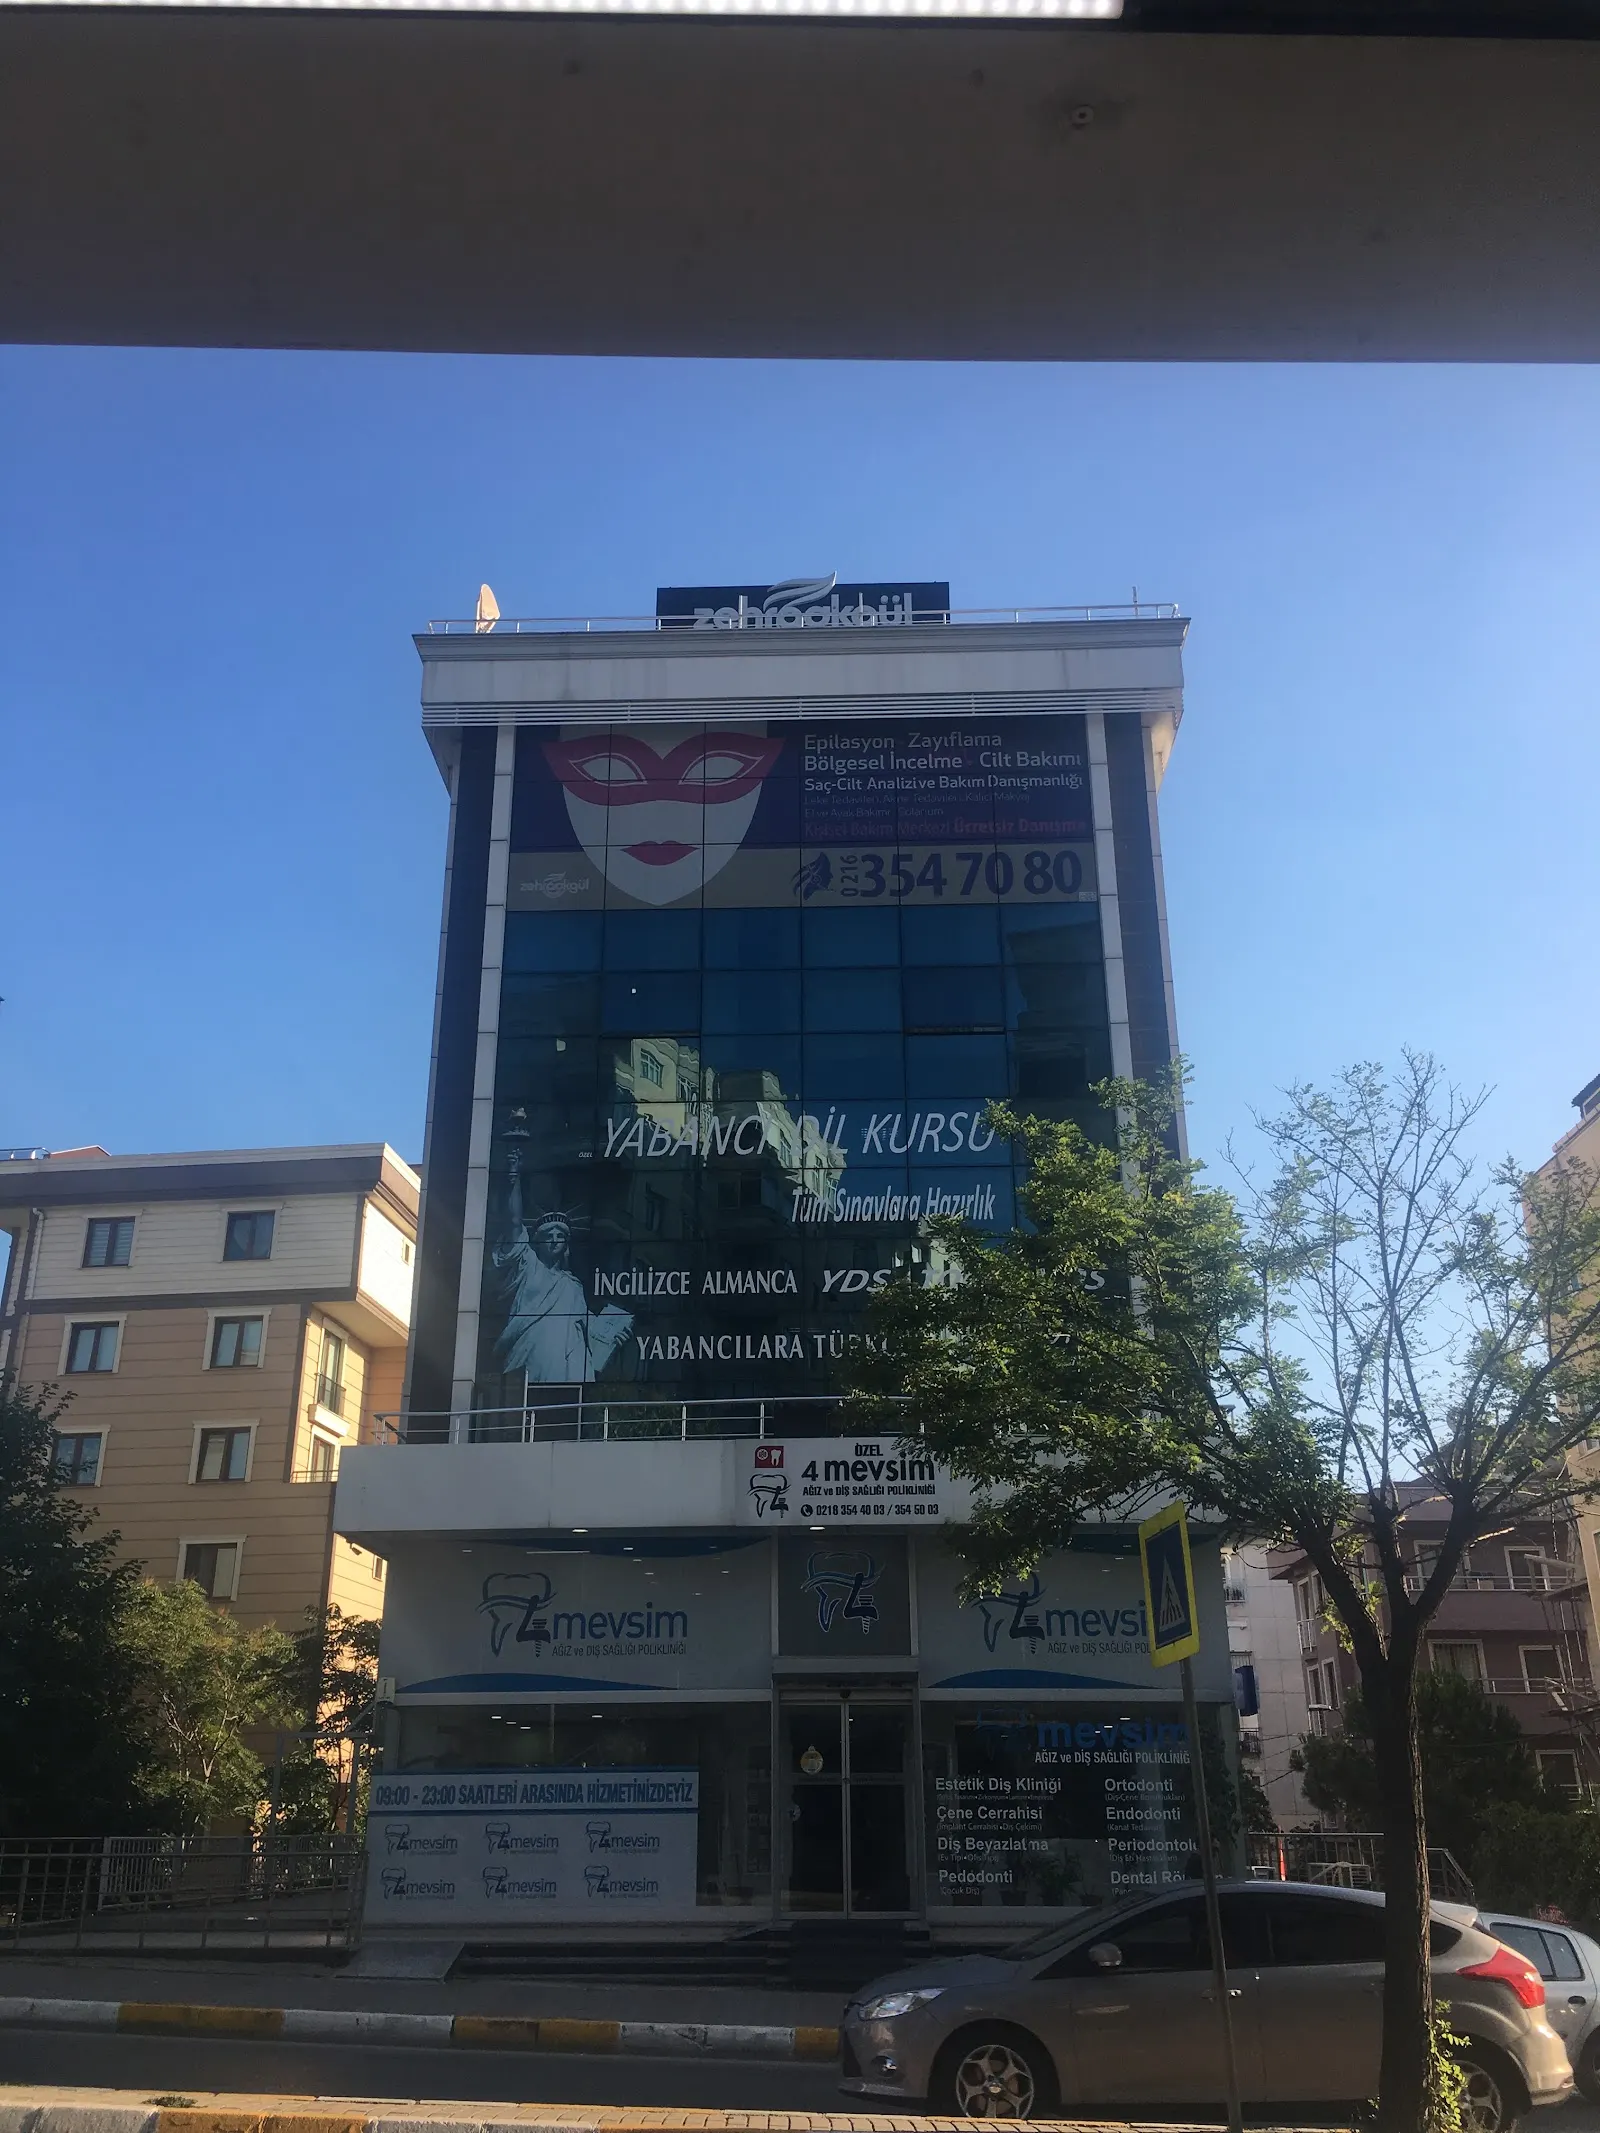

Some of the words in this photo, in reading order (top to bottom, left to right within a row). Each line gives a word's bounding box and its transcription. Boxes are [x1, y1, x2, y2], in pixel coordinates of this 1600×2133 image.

[804, 733, 895, 752] Epilasyon
[907, 732, 1002, 750] Zayıflama
[804, 755, 885, 775] Bölgesel
[890, 753, 963, 769] İncelme
[979, 752, 1012, 767] Cilt
[1016, 751, 1082, 768] Bakımı
[804, 777, 863, 795] Saç-Cilt
[938, 774, 985, 789] Bakım
[987, 774, 1084, 792] Danışmanlığı
[860, 852, 948, 898] 354
[955, 851, 1014, 897] 70
[1023, 850, 1083, 895] 80
[602, 1114, 769, 1158] YABANCI
[862, 1111, 995, 1154] KURSU
[790, 1190, 829, 1223] Tüm
[833, 1189, 921, 1222] Sınavlara
[925, 1184, 997, 1220] Hazırlık
[594, 1267, 690, 1296] İNGİLİZCE
[702, 1269, 798, 1294] ALMANCA
[821, 1268, 893, 1293] YDS
[636, 1335, 804, 1360] YABANCILARA
[854, 1443, 884, 1457] ÖZEL
[801, 1460, 819, 1482] 4
[824, 1457, 935, 1482] mevsim
[802, 1485, 822, 1497] AĞIZ
[823, 1487, 834, 1496] ve
[835, 1485, 850, 1498] DİŞ
[852, 1484, 885, 1496] SAĞLIĞI
[840, 1504, 858, 1516] 354
[860, 1504, 872, 1516] 40
[873, 1504, 885, 1516] 03
[895, 1503, 912, 1515] 354
[914, 1503, 926, 1515] 50
[927, 1503, 939, 1515] 03
[552, 1644, 573, 1656] AĞIZ
[574, 1647, 584, 1656] ve
[1069, 1645, 1080, 1654] ve
[1034, 1751, 1057, 1764] AĞIZ
[1059, 1753, 1072, 1763] ve
[1074, 1750, 1091, 1767] DİŞ
[1096, 1749, 1132, 1765] SAĞLIĞI
[457, 1779, 517, 1804] SAATLERİ
[520, 1782, 584, 1804] ARASINDA
[587, 1778, 693, 1802] HİZMETİNİZDEYİZ
[935, 1777, 985, 1791] Estetik
[988, 1777, 1012, 1793] Diş
[1016, 1777, 1062, 1794] Kliniği
[1104, 1778, 1173, 1792] Ortodonti
[936, 1806, 974, 1822] Çene
[977, 1806, 1043, 1820] Cerrahisi
[1105, 1806, 1181, 1820] Endodonti
[937, 1837, 961, 1853] Diş
[965, 1836, 1049, 1854] Beyazlatma
[938, 1869, 1013, 1883] Pedodonti
[1110, 1870, 1157, 1884] Dental
